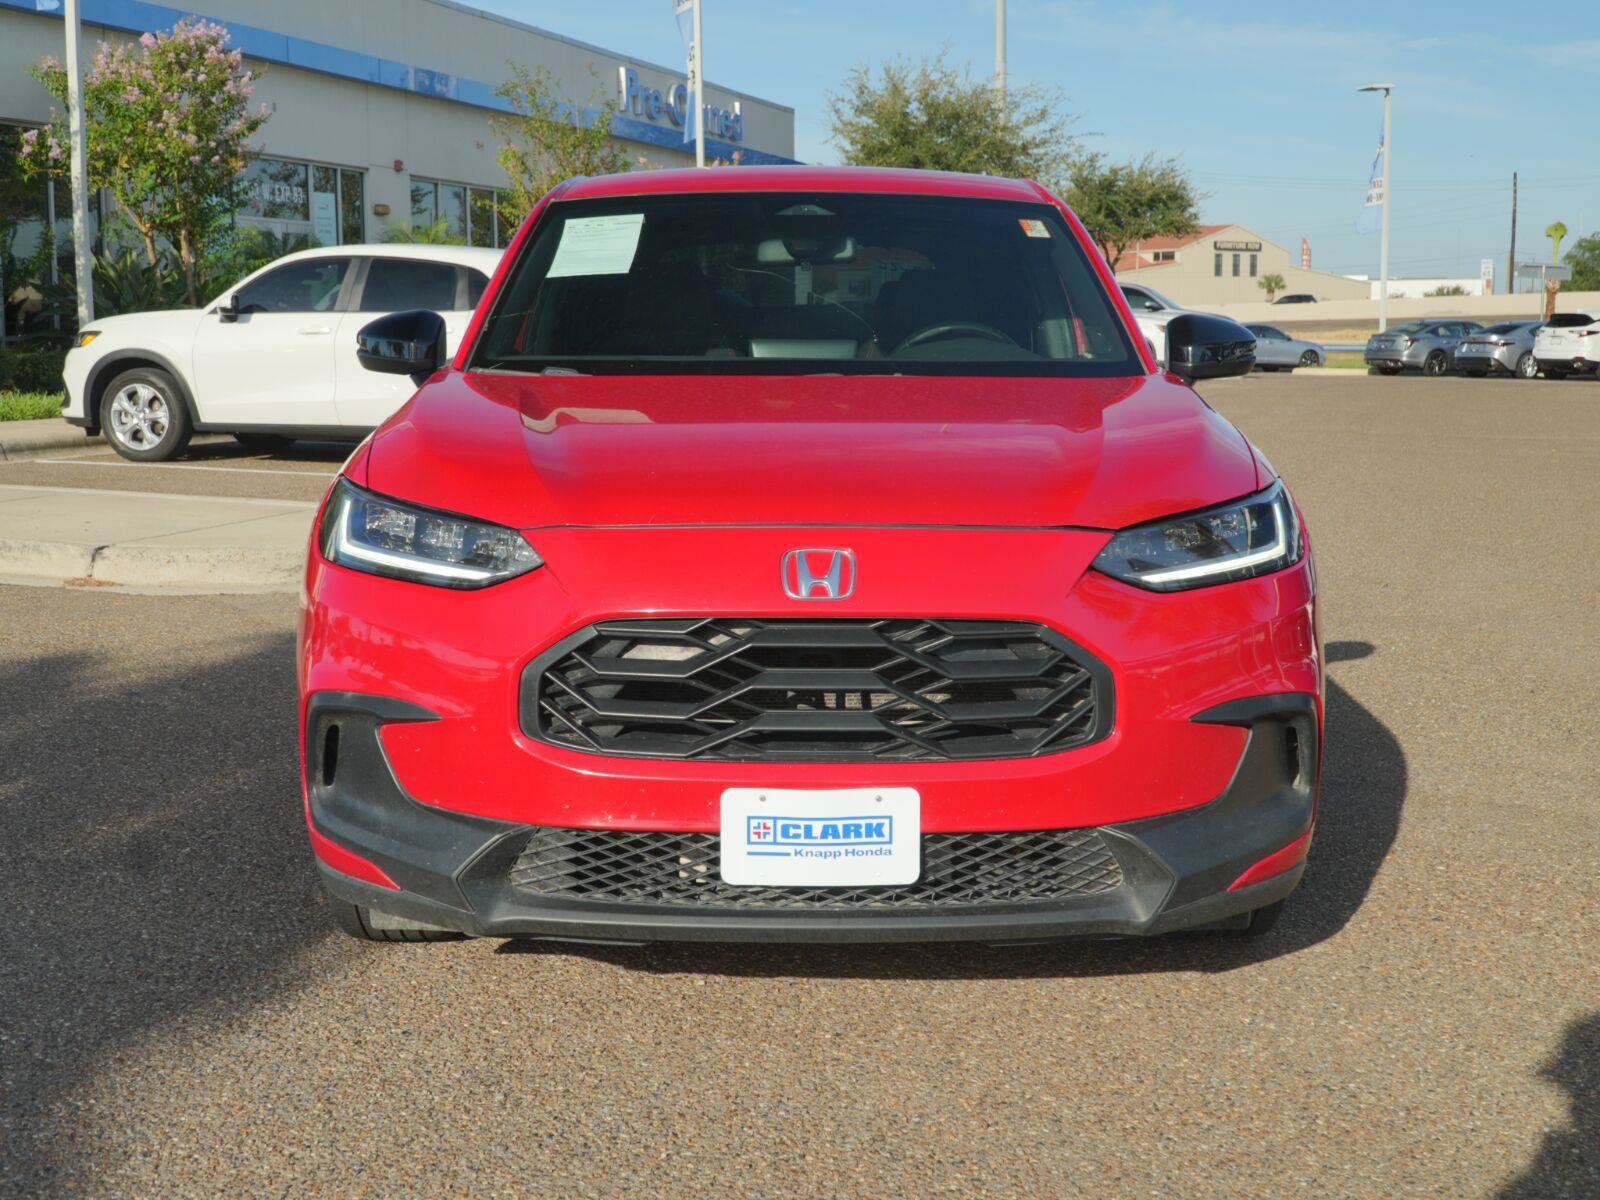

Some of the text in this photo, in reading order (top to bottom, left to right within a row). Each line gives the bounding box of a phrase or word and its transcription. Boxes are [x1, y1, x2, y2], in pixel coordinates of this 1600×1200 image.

[618, 66, 743, 141] Pre-Oned
[780, 821, 885, 840] CLARK
[793, 847, 892, 860] Knapp Honda
